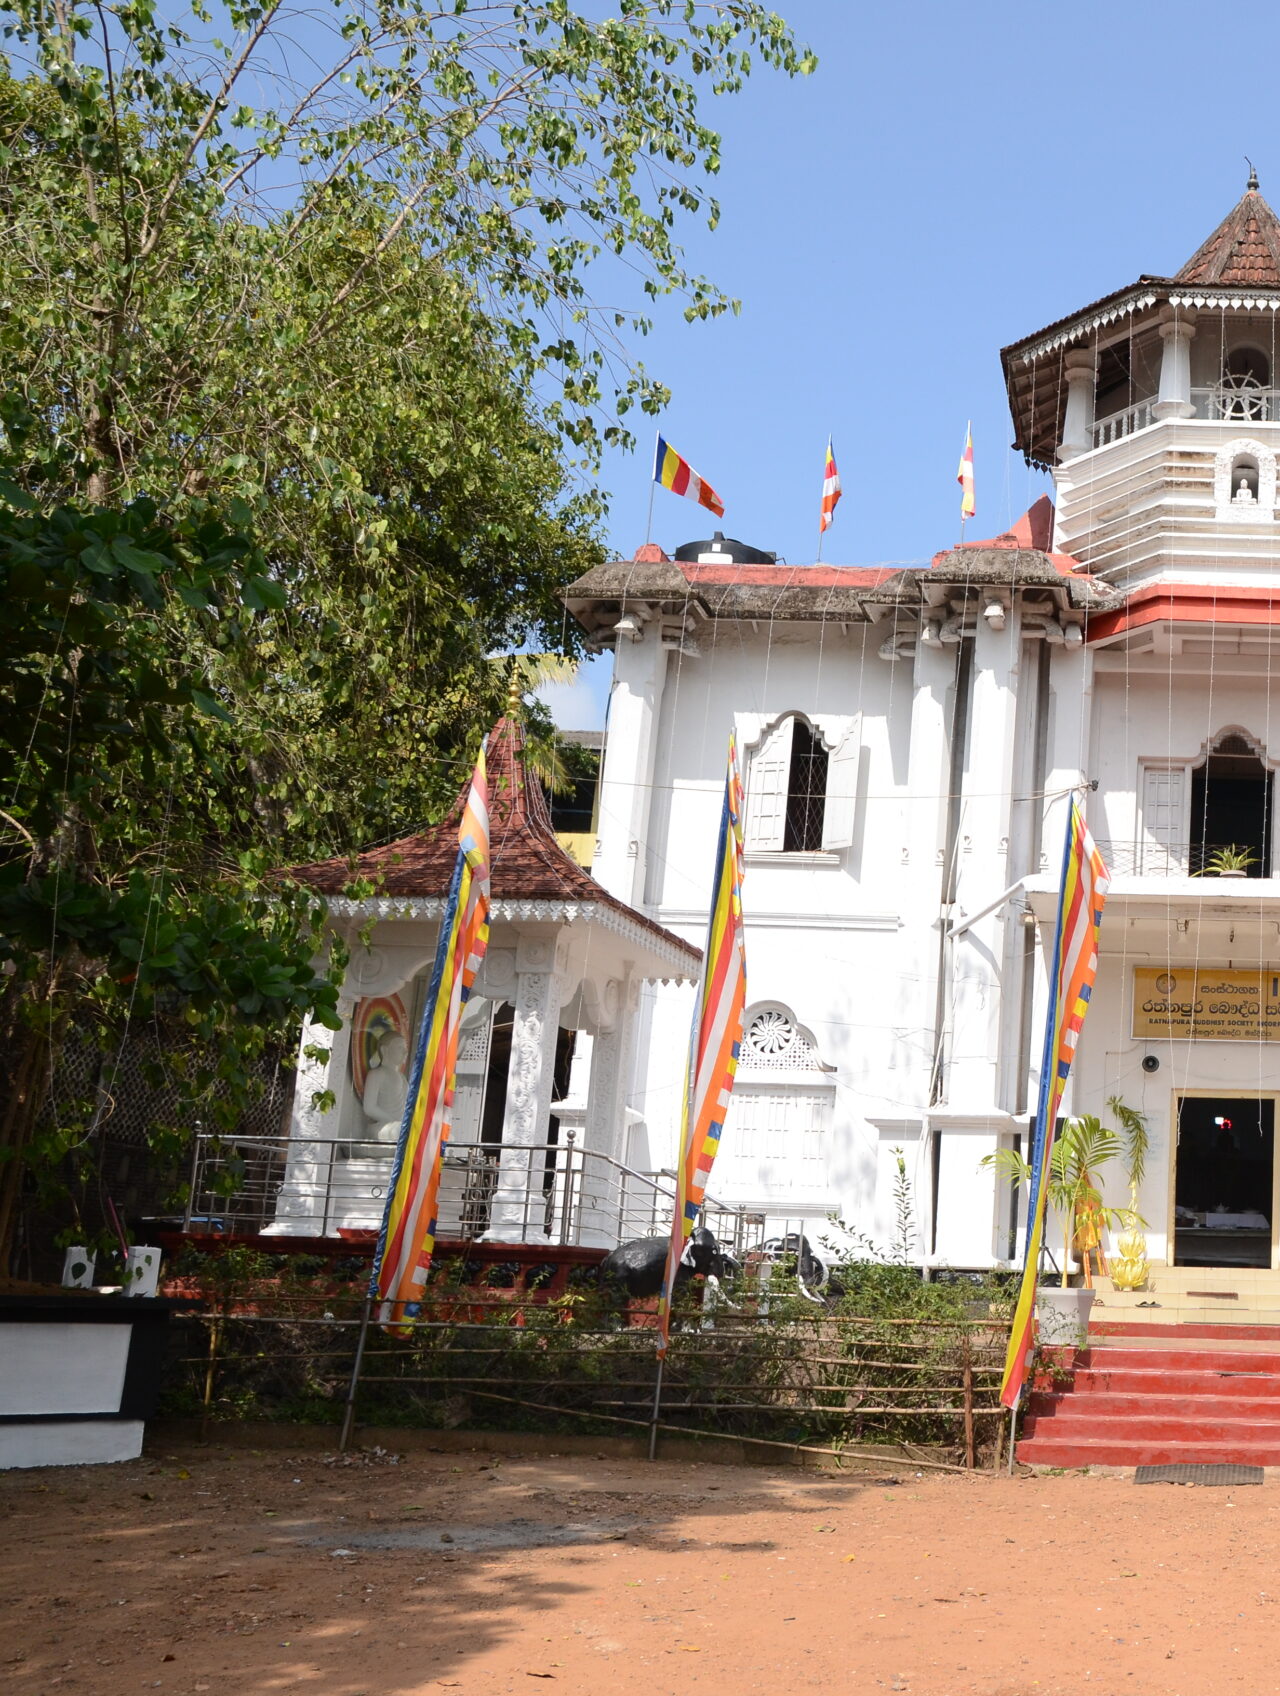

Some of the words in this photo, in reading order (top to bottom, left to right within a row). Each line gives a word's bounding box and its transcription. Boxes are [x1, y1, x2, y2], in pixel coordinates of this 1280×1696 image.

[1200, 982, 1259, 994] සංස්ථාගත
[1142, 999, 1203, 1017] රත්නපුර
[1209, 1001, 1260, 1018] බෞද්ධ
